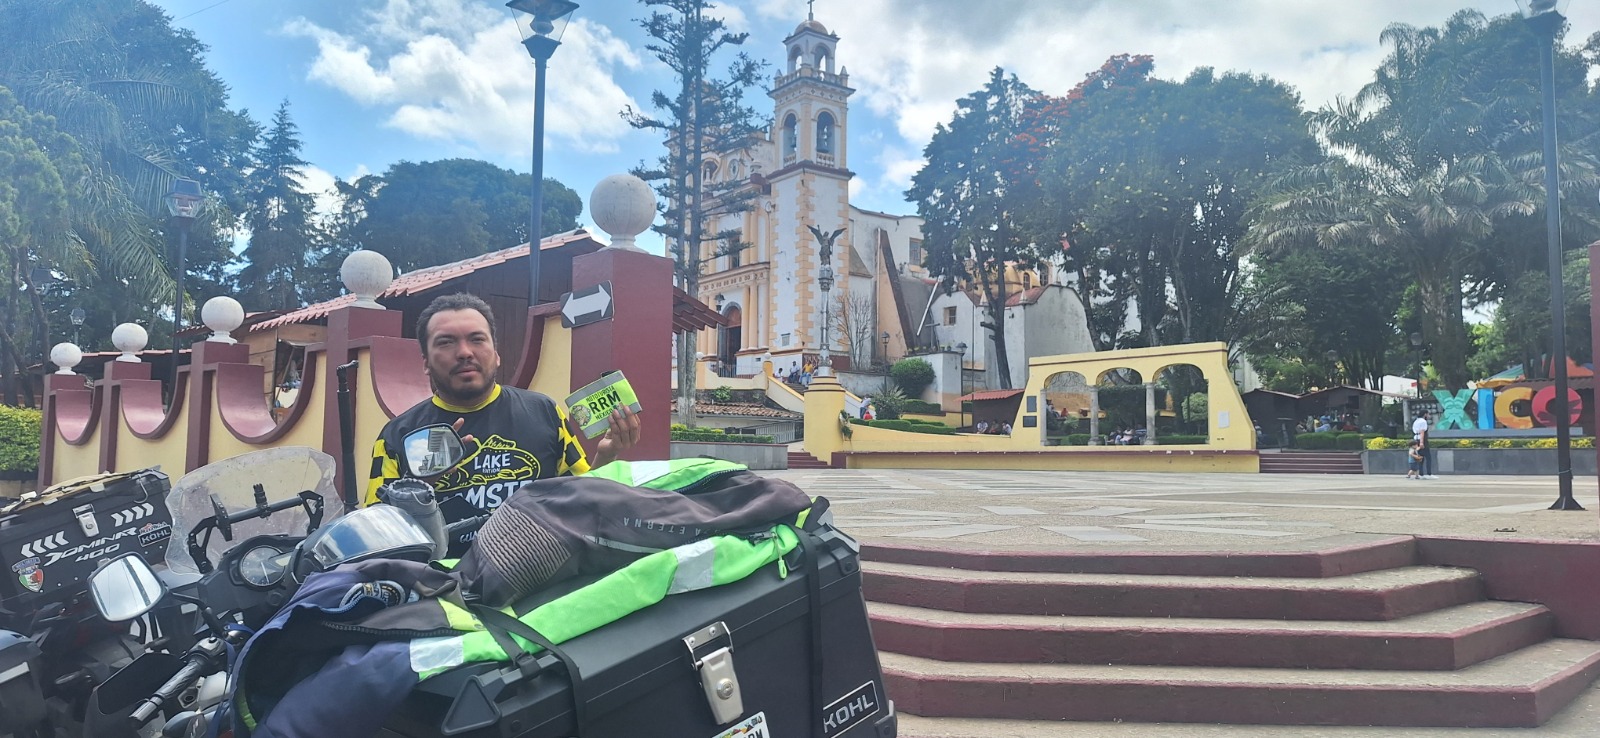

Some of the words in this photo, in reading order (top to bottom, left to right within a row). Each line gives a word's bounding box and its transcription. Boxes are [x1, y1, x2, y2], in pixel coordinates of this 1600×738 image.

[588, 390, 622, 415] RRM
[1431, 385, 1583, 430] XICO
[474, 453, 511, 470] LAKE
[623, 517, 686, 535] ETERNA
[141, 528, 172, 545] KOHL
[75, 543, 121, 563] 400
[823, 694, 875, 734] KOHL
